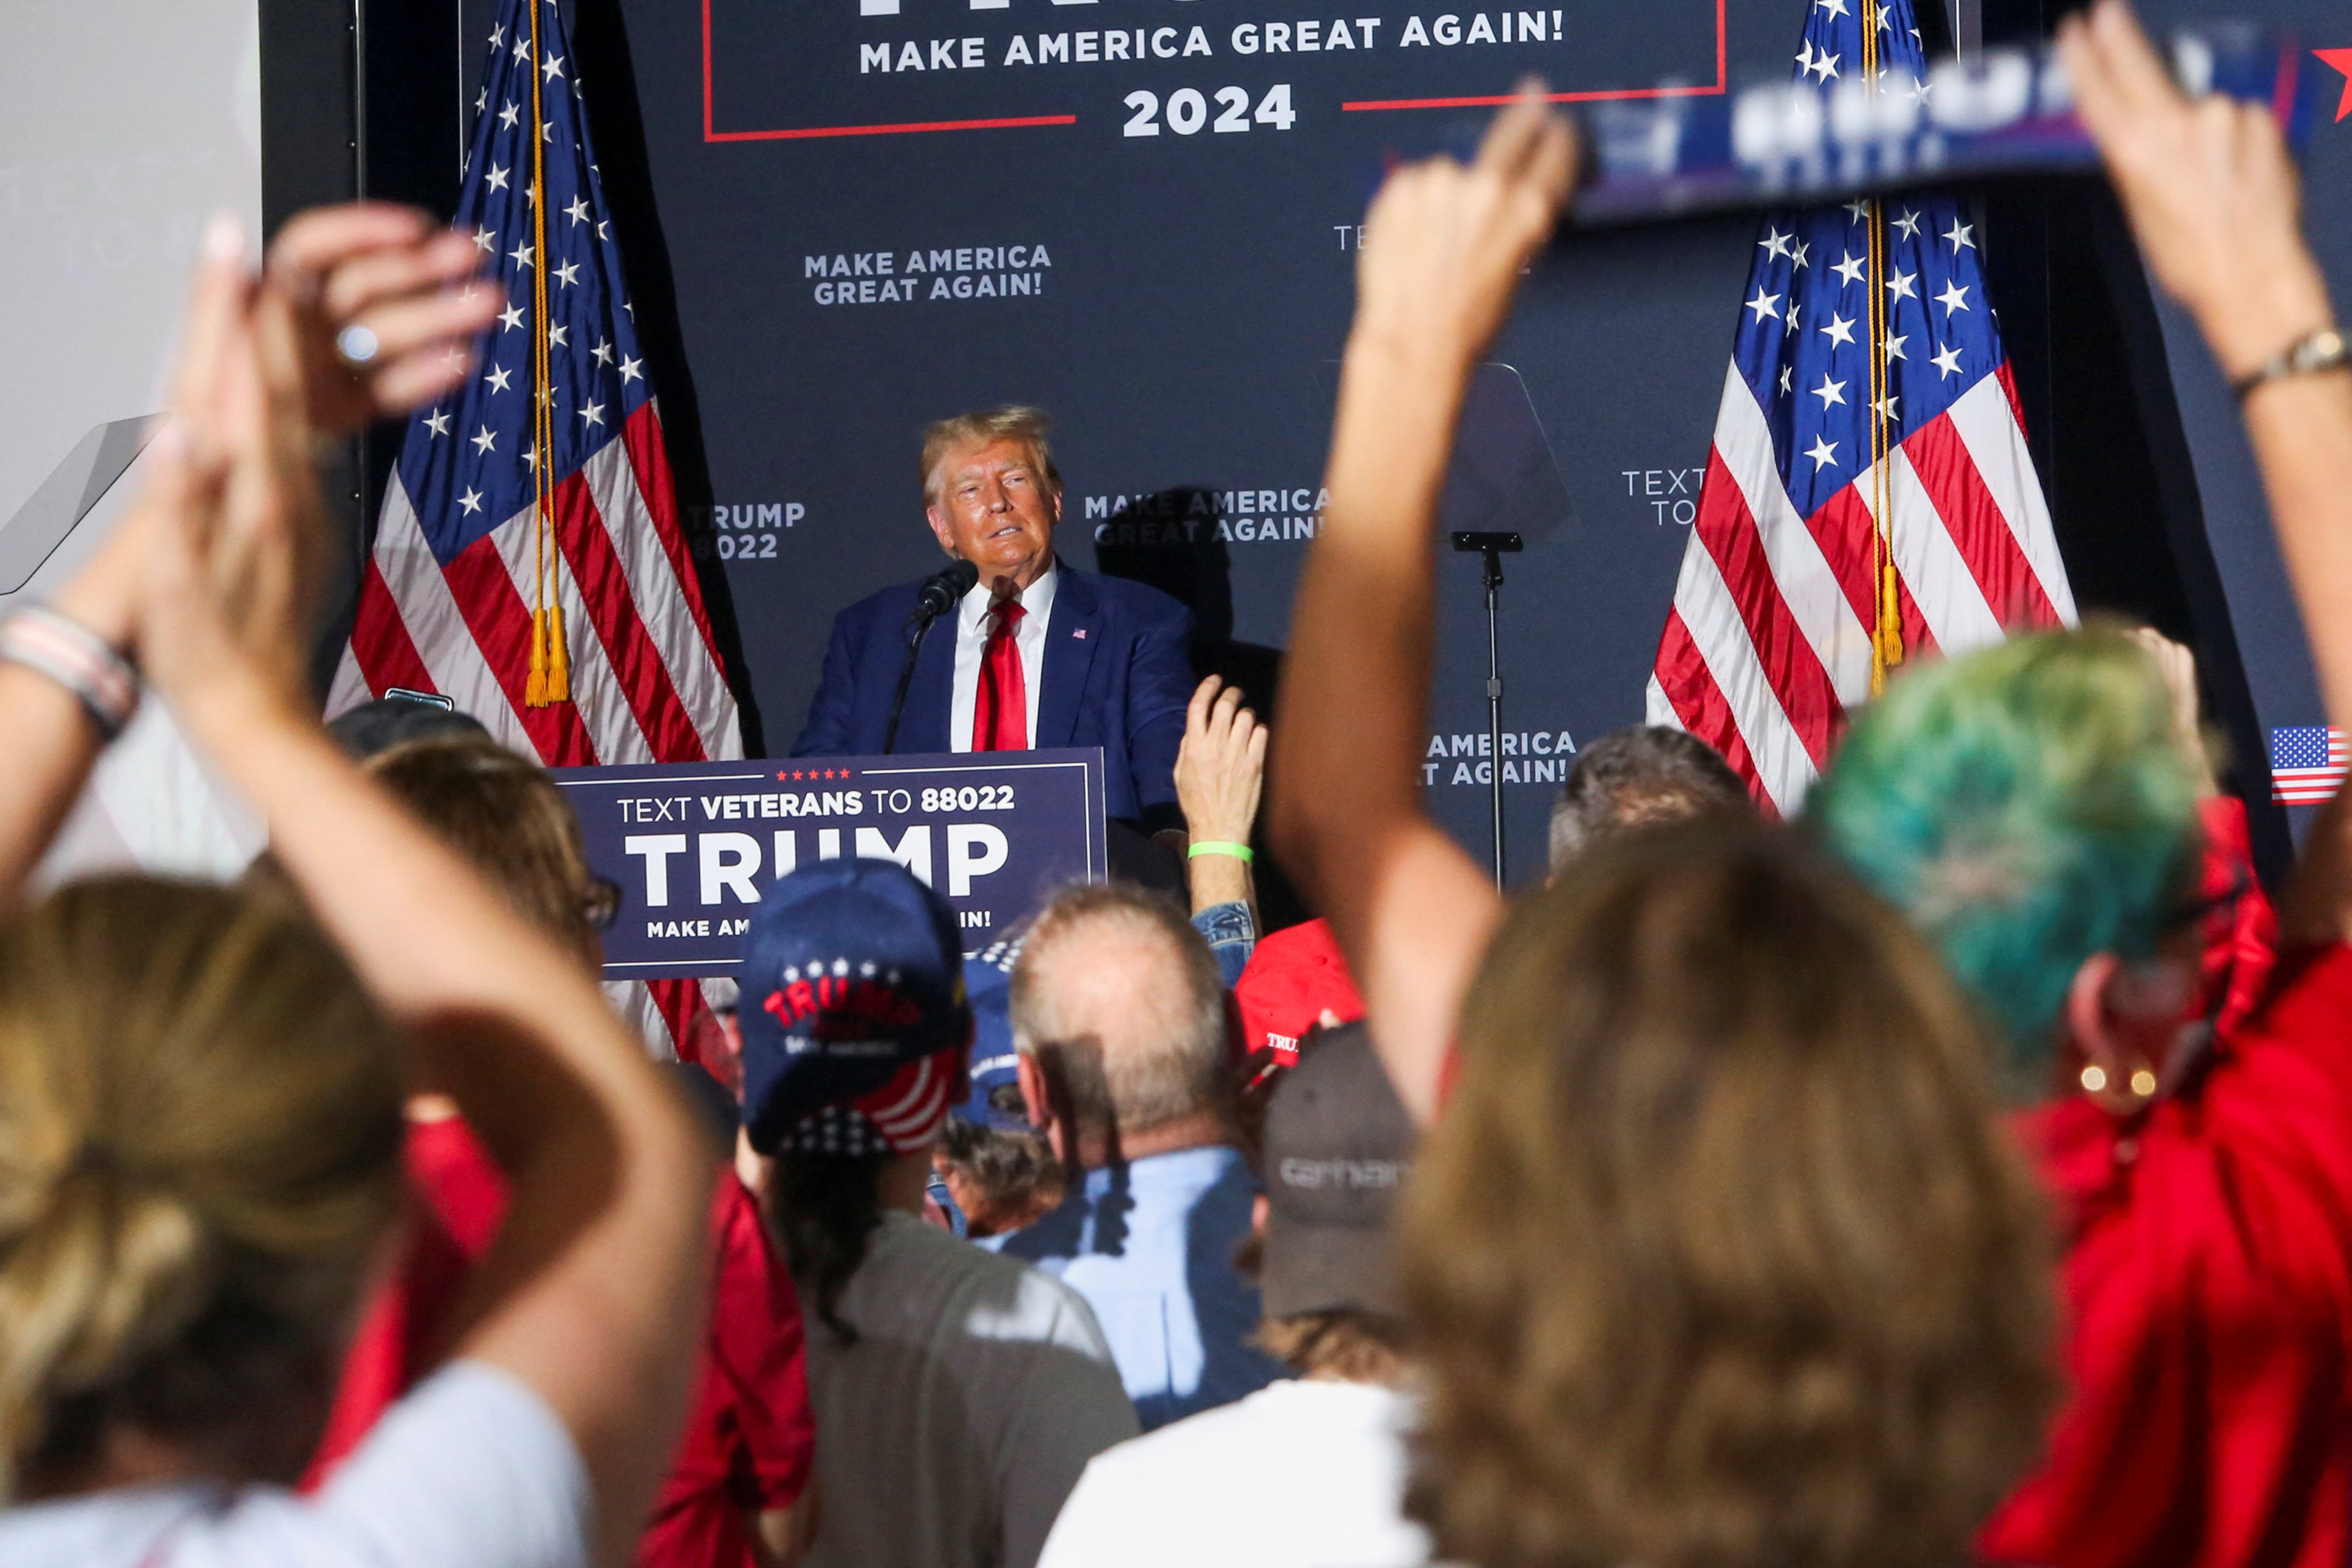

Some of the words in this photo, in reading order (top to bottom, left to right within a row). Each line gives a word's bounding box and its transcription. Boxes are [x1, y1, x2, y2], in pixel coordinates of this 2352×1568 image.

[860, 37, 985, 74] MAKE
[1003, 26, 1213, 66] AMERICA
[1231, 18, 1381, 54] GREAT
[1399, 10, 1563, 47] AGAIN!
[1123, 83, 1296, 137] 2024
[1333, 224, 1368, 250] TE
[805, 252, 894, 278] MAKE
[905, 245, 1051, 274] AMERICA
[814, 278, 918, 305] GREAT
[929, 272, 1042, 300] AGAIN!
[1622, 468, 1706, 496] TEXT
[1085, 494, 1173, 519] MAKE
[1188, 488, 1333, 515] AMERICA
[1651, 499, 1696, 526] TO
[1094, 520, 1200, 543] GREAT
[1212, 515, 1326, 541] AGAIN!
[1426, 731, 1577, 757] AMERICA
[1451, 759, 1566, 785] AGAIN!
[616, 797, 692, 823] TEXT
[700, 791, 863, 820] VETERANS
[871, 789, 912, 814] TO
[921, 785, 1015, 812] 88022
[624, 823, 1009, 907] TRUMP
[647, 920, 710, 938] MAKE
[960, 911, 991, 928] IN!
[1266, 1032, 1299, 1053] TRU
